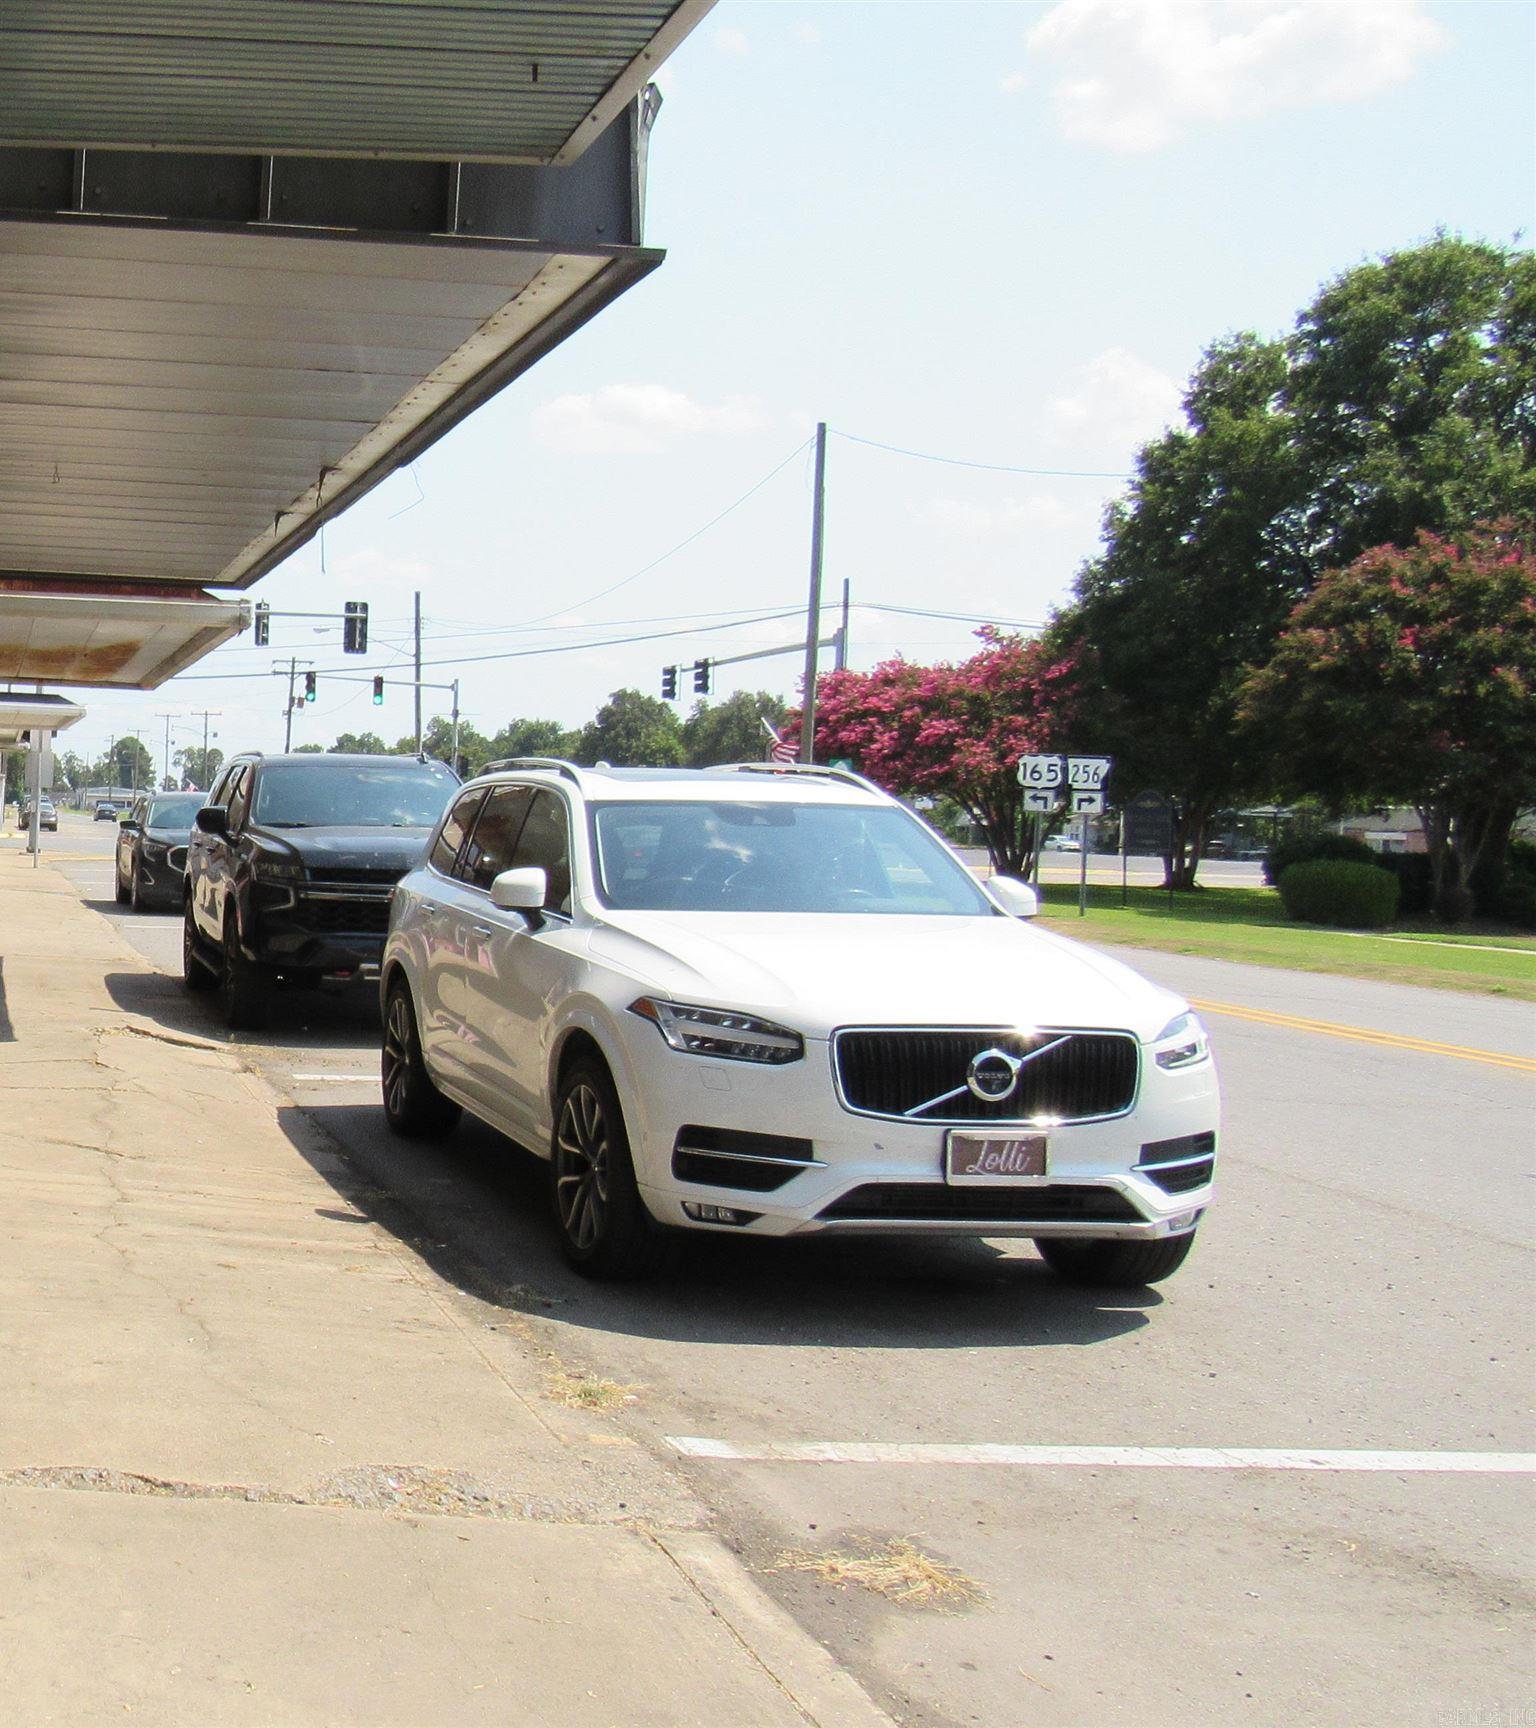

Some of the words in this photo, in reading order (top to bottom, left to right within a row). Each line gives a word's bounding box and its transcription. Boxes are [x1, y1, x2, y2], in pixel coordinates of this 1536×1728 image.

[1021, 762, 1058, 782] 165
[1071, 764, 1100, 784] 256
[966, 1140, 1031, 1177] Lolli
